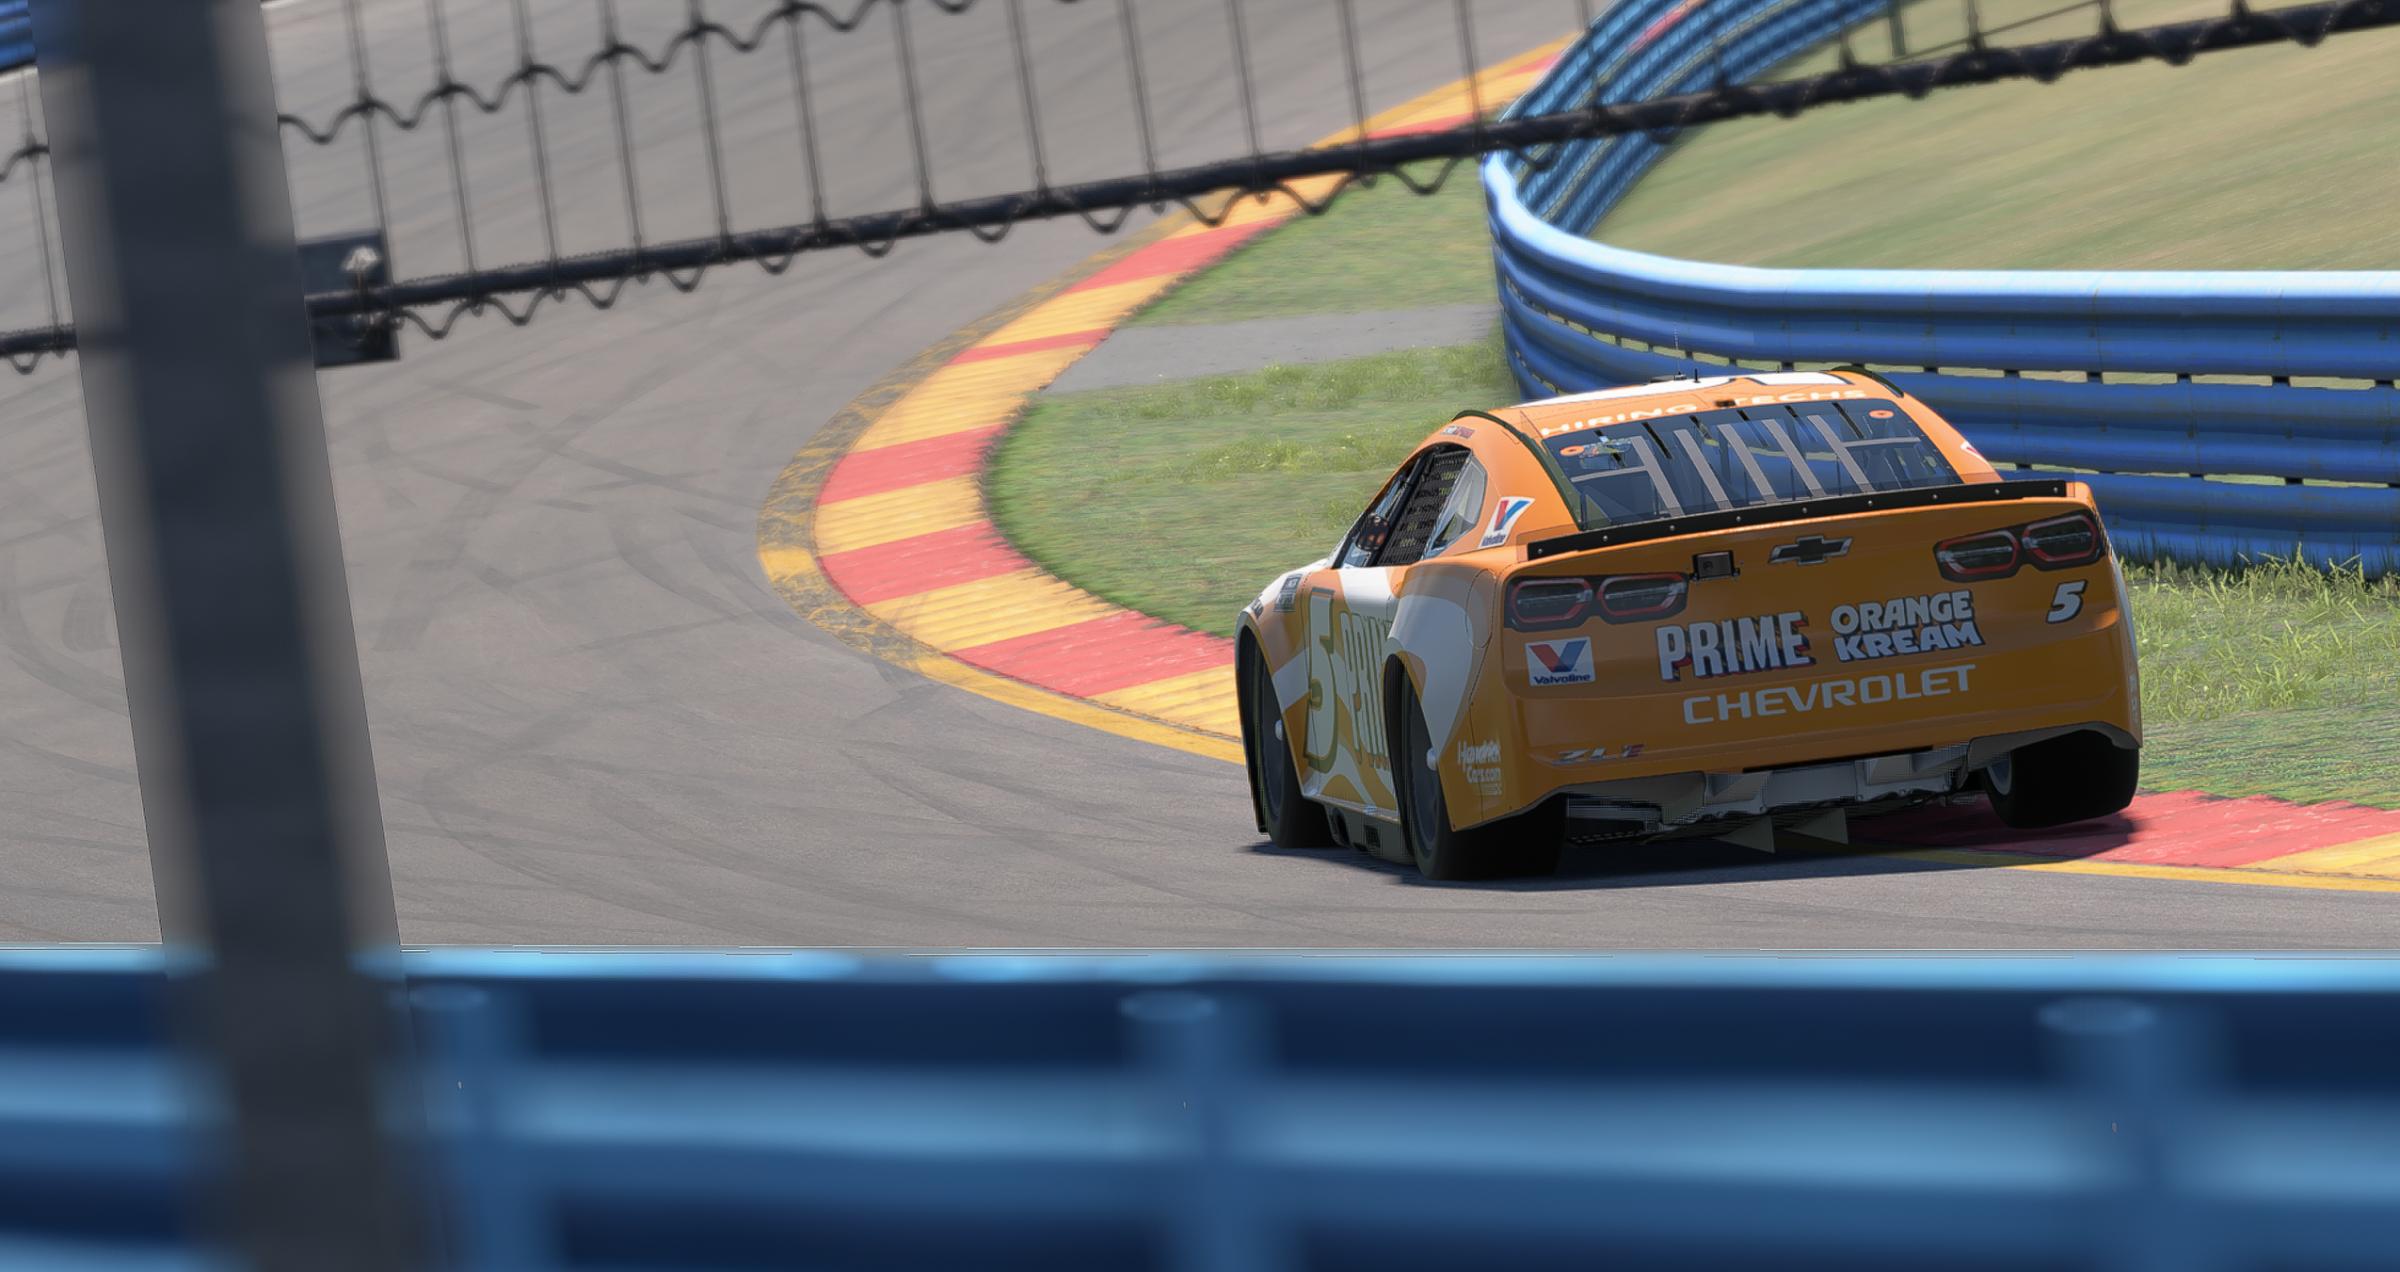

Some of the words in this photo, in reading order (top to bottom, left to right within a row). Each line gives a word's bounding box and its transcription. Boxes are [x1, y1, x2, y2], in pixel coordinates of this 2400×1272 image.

[1540, 403, 1697, 436] HIRING
[1733, 389, 1867, 405] TECHS
[1830, 589, 1974, 635] ORANGE
[2047, 579, 2088, 625] 5
[1655, 611, 1815, 682] PRIME
[1832, 620, 1985, 662] KREAM
[1303, 586, 1338, 774] 5
[1533, 674, 1591, 685] Valvoline
[1683, 664, 1976, 725] CHEVROLET
